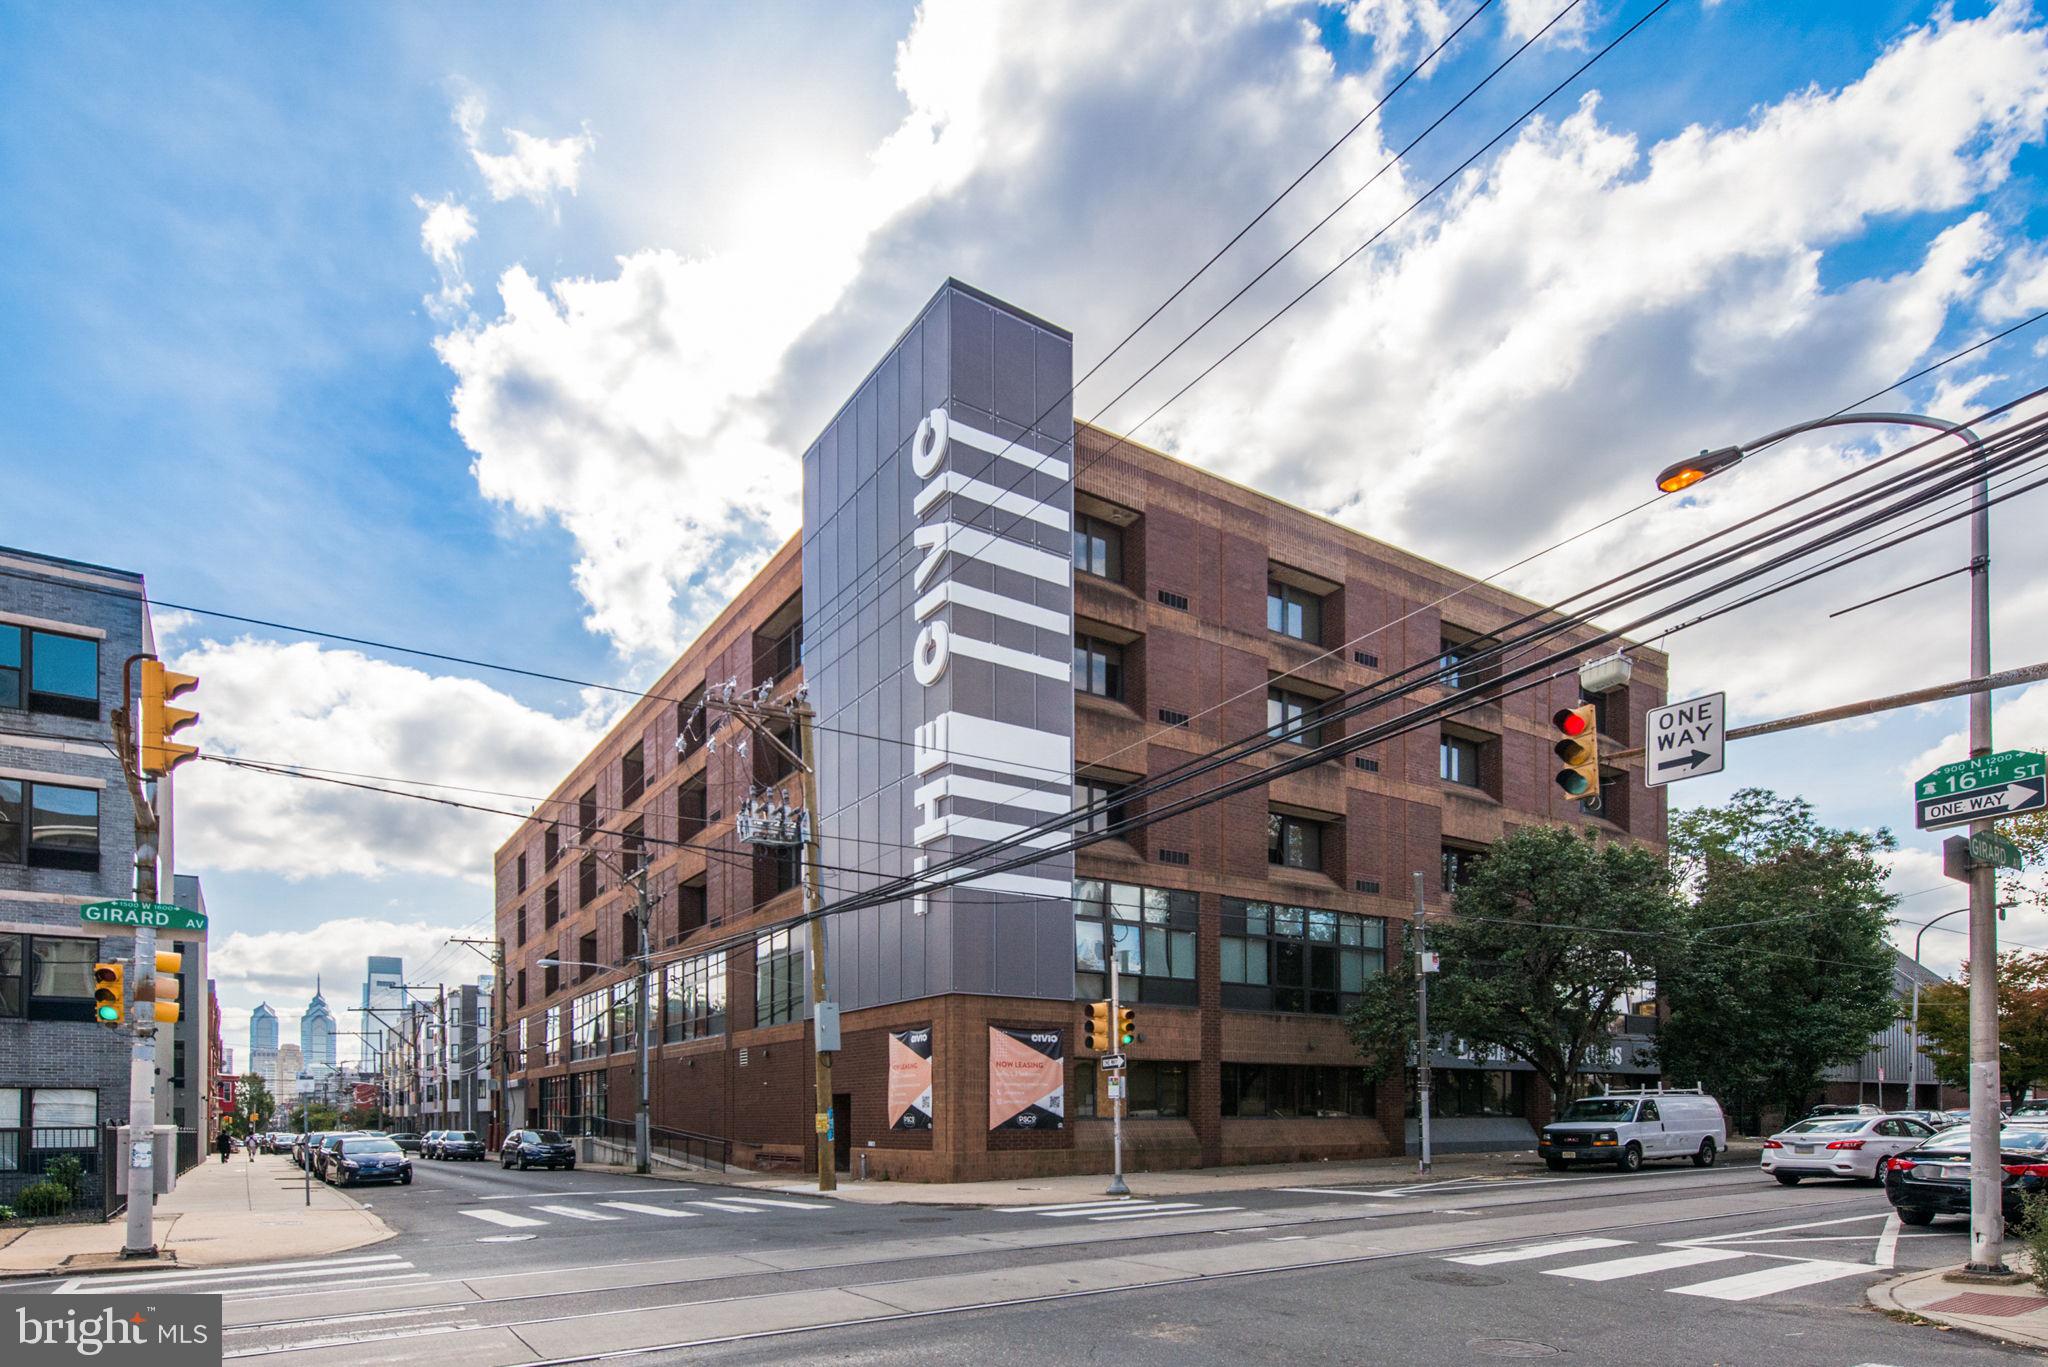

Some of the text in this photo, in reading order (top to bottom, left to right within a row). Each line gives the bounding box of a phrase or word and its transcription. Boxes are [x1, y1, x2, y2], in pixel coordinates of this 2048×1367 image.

[912, 408, 951, 916] THE CIVIC
[1659, 702, 1712, 730] ONE
[1657, 723, 1713, 752] WAY
[1944, 754, 2013, 774] 900 N 1200
[1945, 763, 2040, 793] 16TH ST
[1930, 793, 2005, 818] ONE WAY
[1971, 838, 2007, 865] GIRARD
[86, 906, 204, 928] GIRARD AV
[142, 902, 151, 910] W
